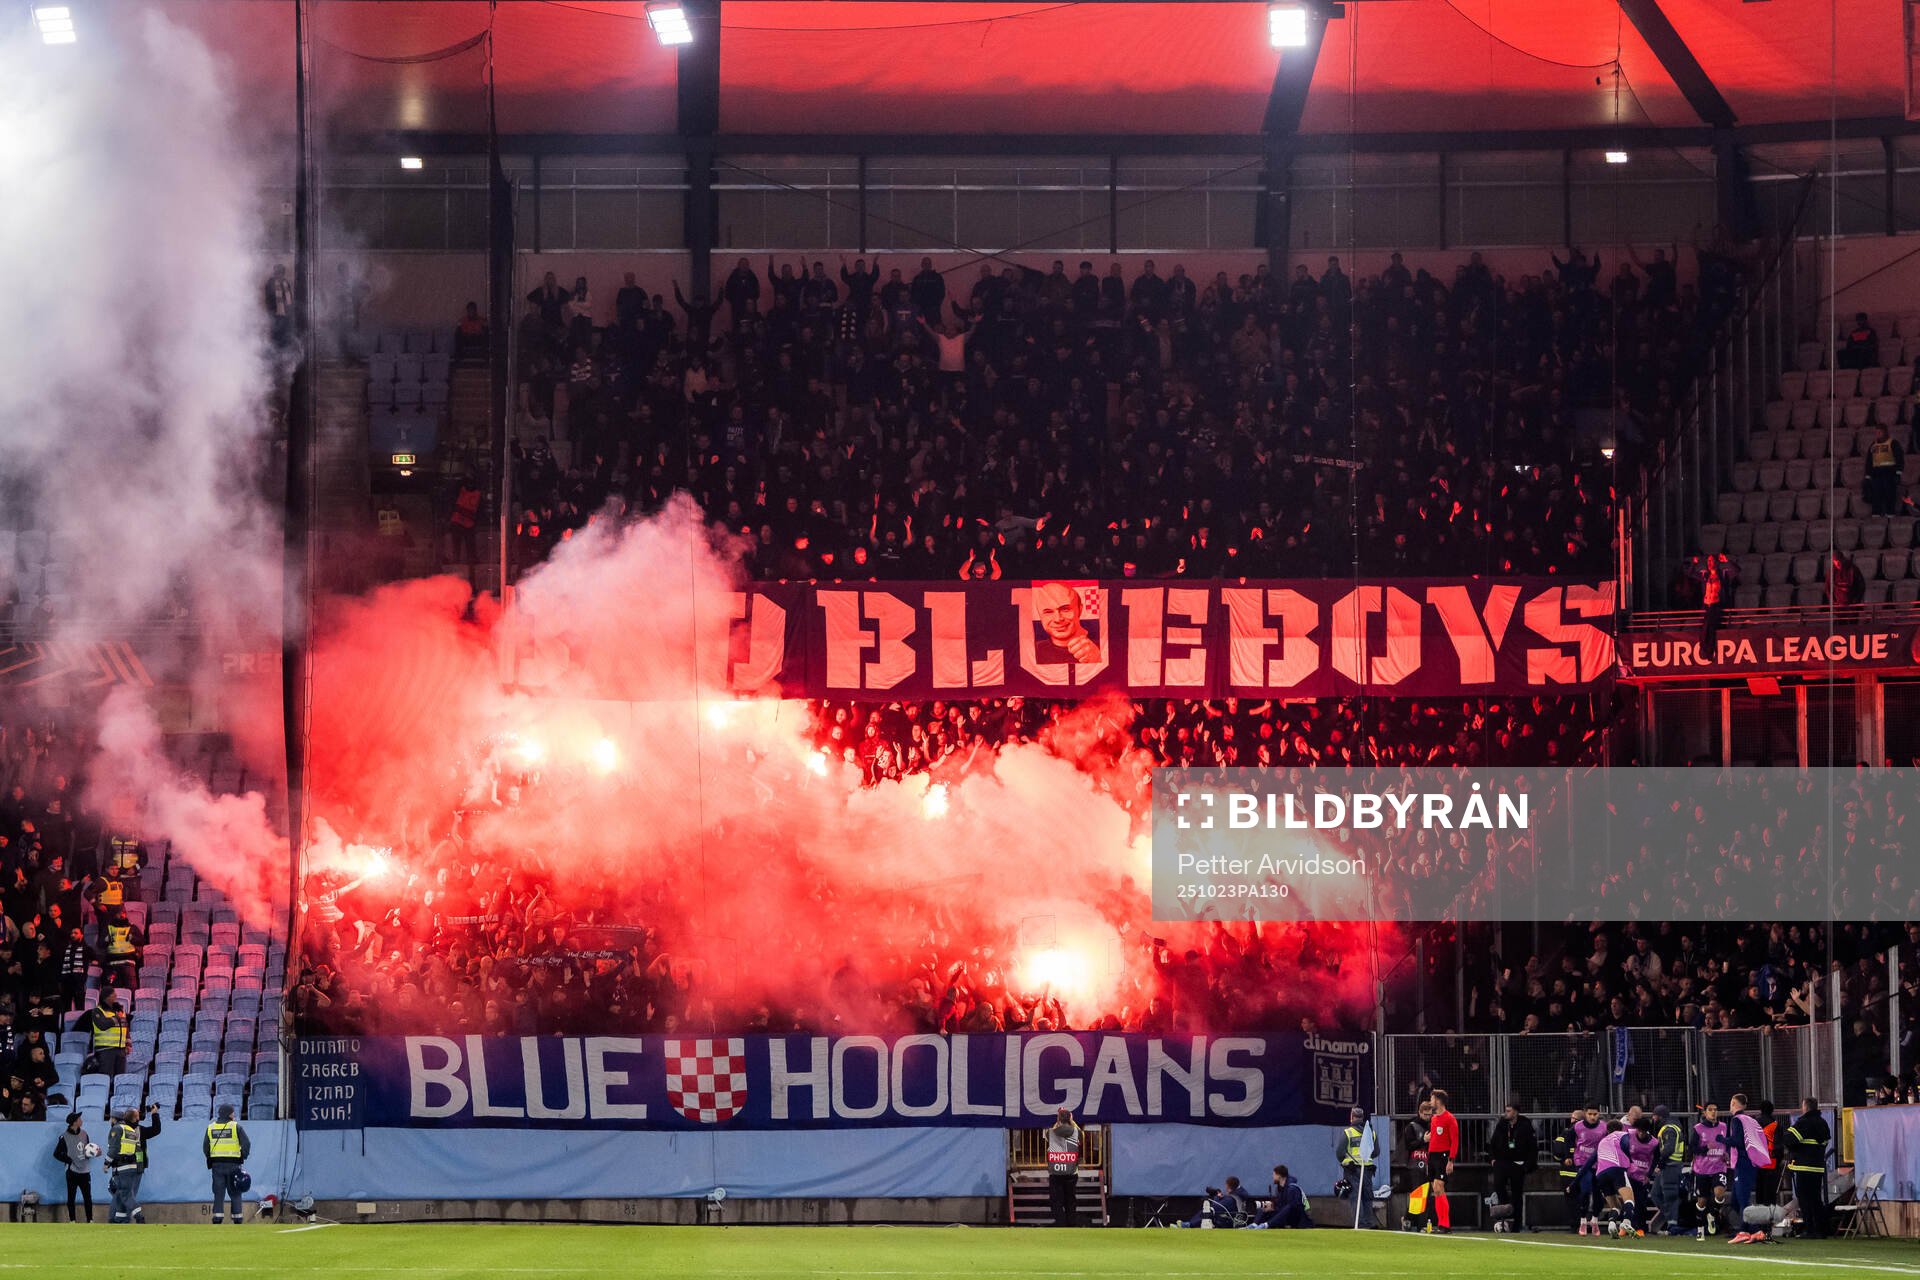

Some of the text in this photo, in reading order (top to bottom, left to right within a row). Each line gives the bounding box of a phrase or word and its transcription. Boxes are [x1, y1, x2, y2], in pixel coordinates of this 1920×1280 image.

[300, 1039, 360, 1055] DINAMO
[1303, 1032, 1369, 1054] dinamo
[301, 1062, 360, 1078] ZAGREB
[405, 1033, 1267, 1119] BLUE HOOLIGANS
[1049, 1153, 1076, 1162] PHOTO
[1054, 1163, 1067, 1171] 011
